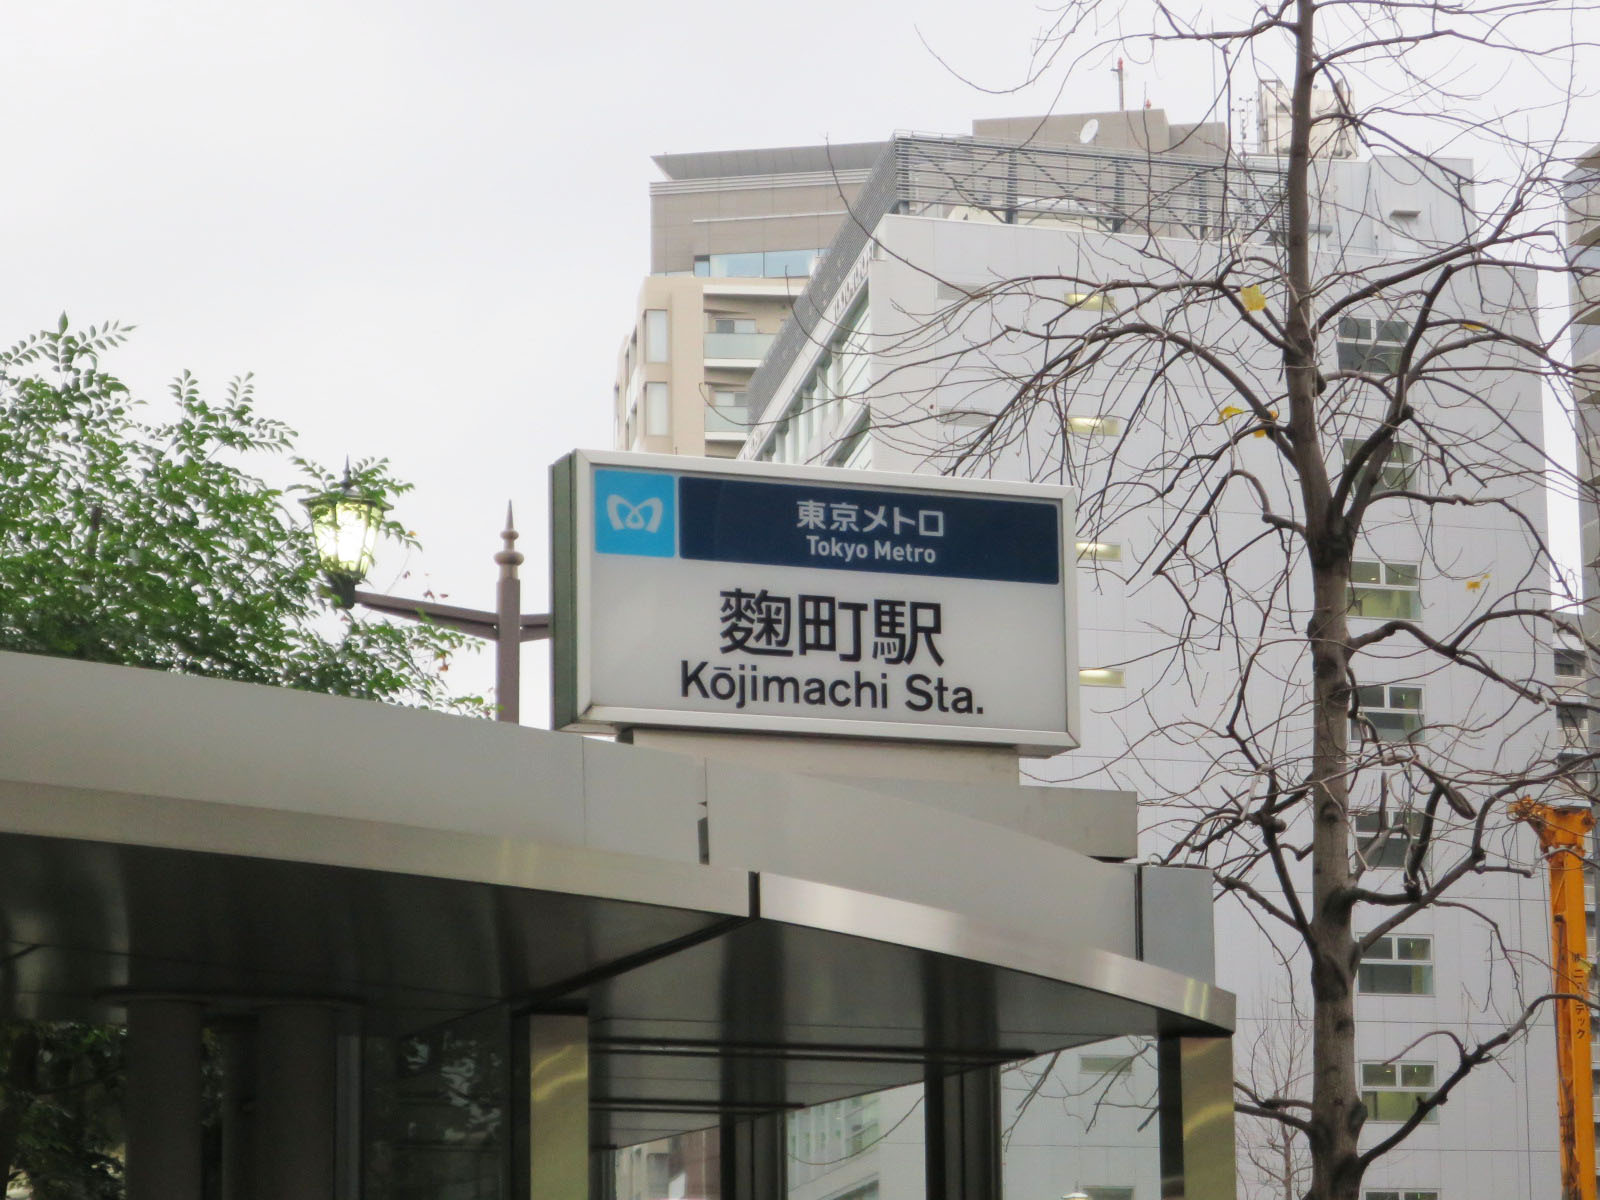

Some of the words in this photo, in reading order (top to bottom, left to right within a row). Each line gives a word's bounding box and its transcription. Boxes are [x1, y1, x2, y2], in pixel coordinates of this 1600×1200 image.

[796, 500, 944, 537] 東京メトロ
[806, 535, 868, 562] Tokyo
[874, 540, 936, 563] Metro
[681, 660, 888, 708] Kōjimachi
[905, 673, 984, 715] Sta.
